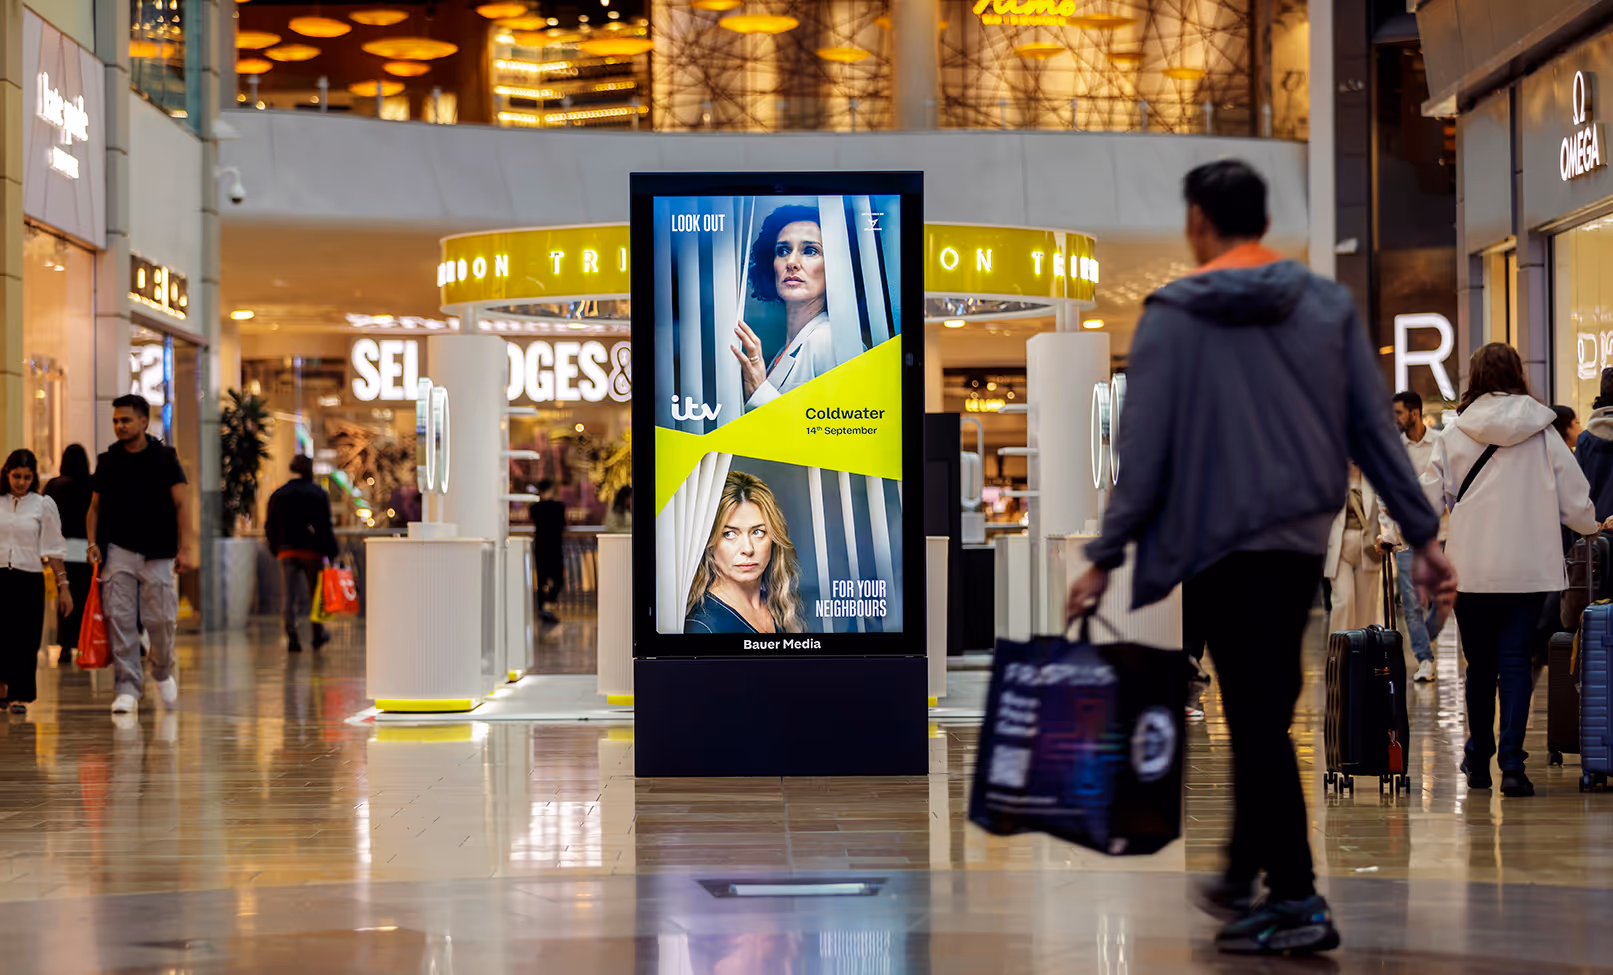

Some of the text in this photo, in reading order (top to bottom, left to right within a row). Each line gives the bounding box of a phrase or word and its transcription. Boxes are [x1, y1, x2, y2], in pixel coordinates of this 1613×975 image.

[973, 0, 1076, 17] umo
[1560, 123, 1601, 182] OMEGA
[671, 213, 726, 232] LOOK OUT
[1394, 313, 1456, 401] R
[671, 394, 723, 421] itv
[805, 407, 886, 420] Coldwater
[806, 426, 878, 437] 14th September
[832, 579, 887, 598] FOR YOUR
[815, 599, 887, 618] NEIGHBOURS
[743, 638, 822, 650] Bauer Media
